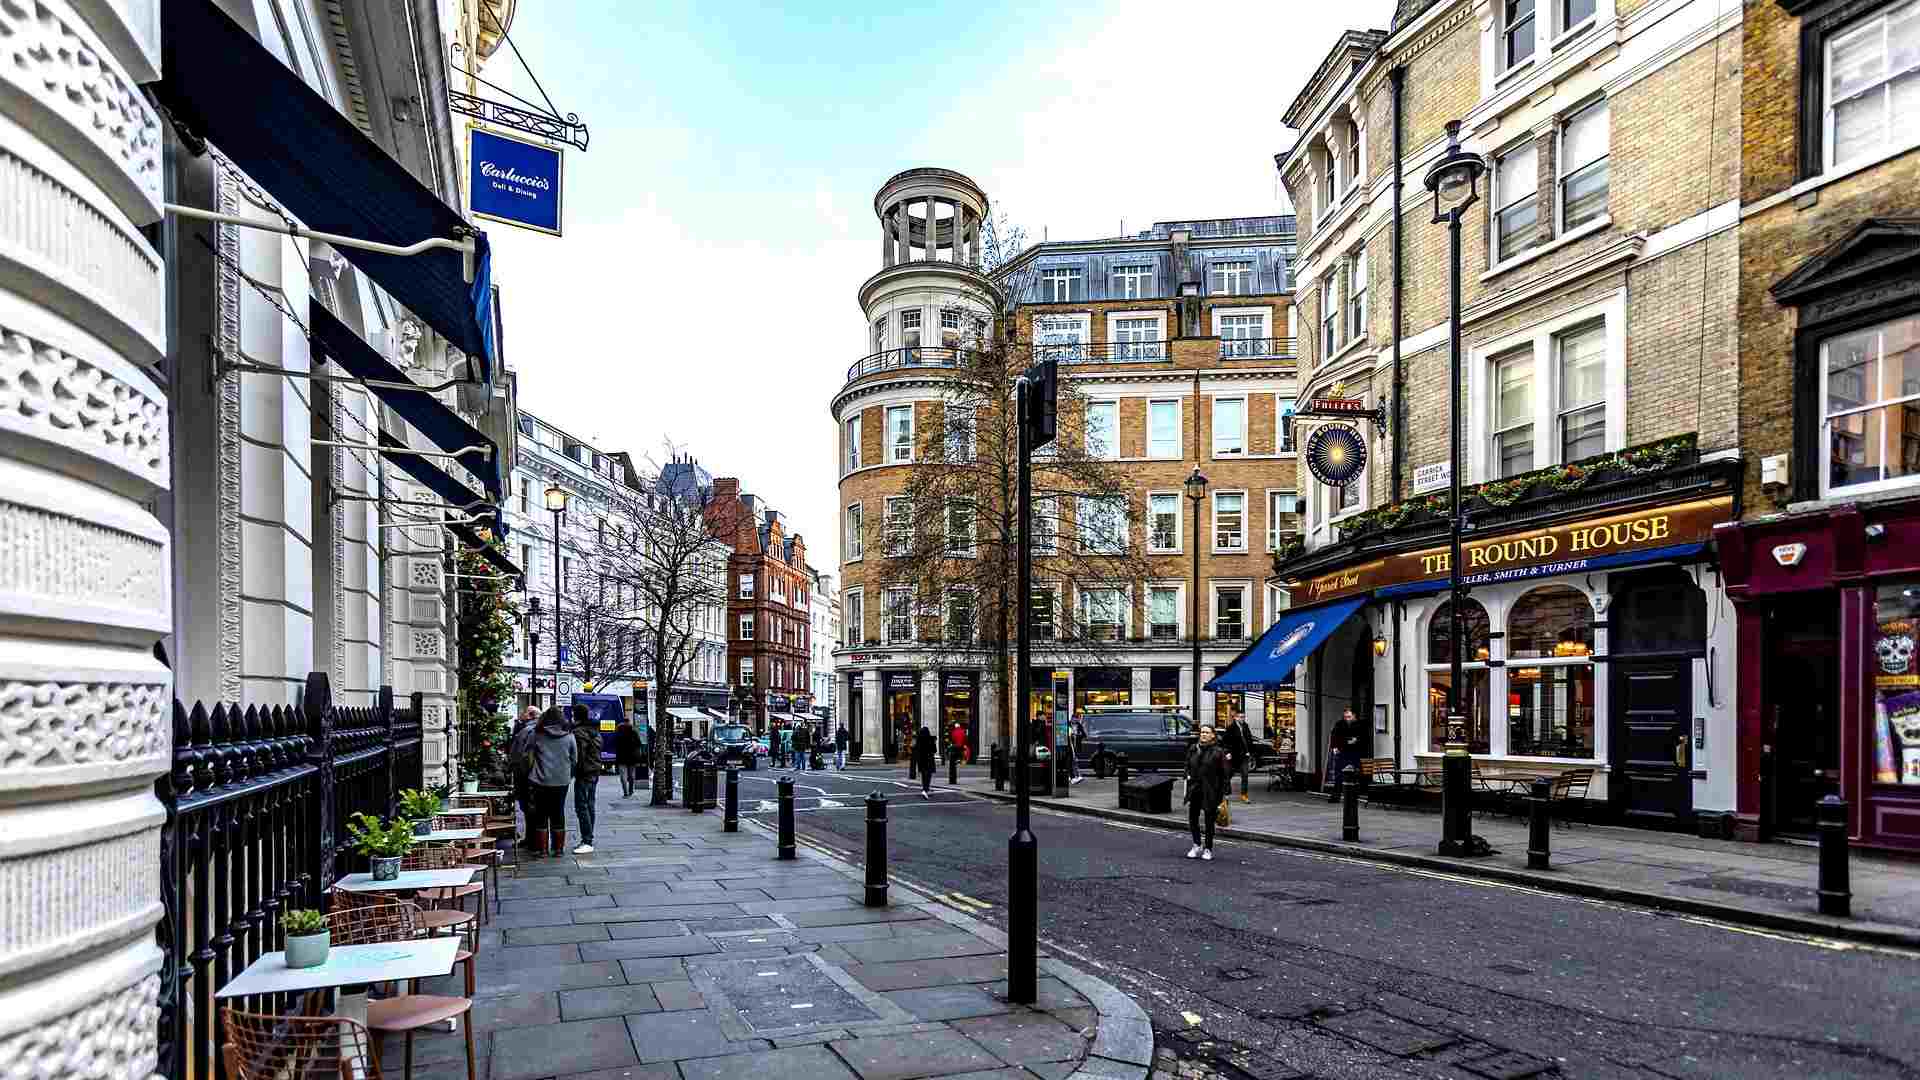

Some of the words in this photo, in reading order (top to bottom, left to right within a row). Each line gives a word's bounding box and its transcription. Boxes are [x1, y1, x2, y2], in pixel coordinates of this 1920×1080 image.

[479, 160, 550, 190] Carluccio's
[492, 181, 506, 190] Deli
[515, 187, 537, 200] Dining
[1317, 423, 1347, 436] ROUND
[1349, 428, 1366, 458] HOUSE
[1420, 551, 1451, 574] TH
[1470, 536, 1557, 567] ROUND
[1569, 516, 1669, 551] HOUSE
[1461, 572, 1491, 585] ULLER,
[1493, 566, 1526, 579] SMITH
[1529, 565, 1538, 575] &
[1541, 559, 1588, 574] TURNER
